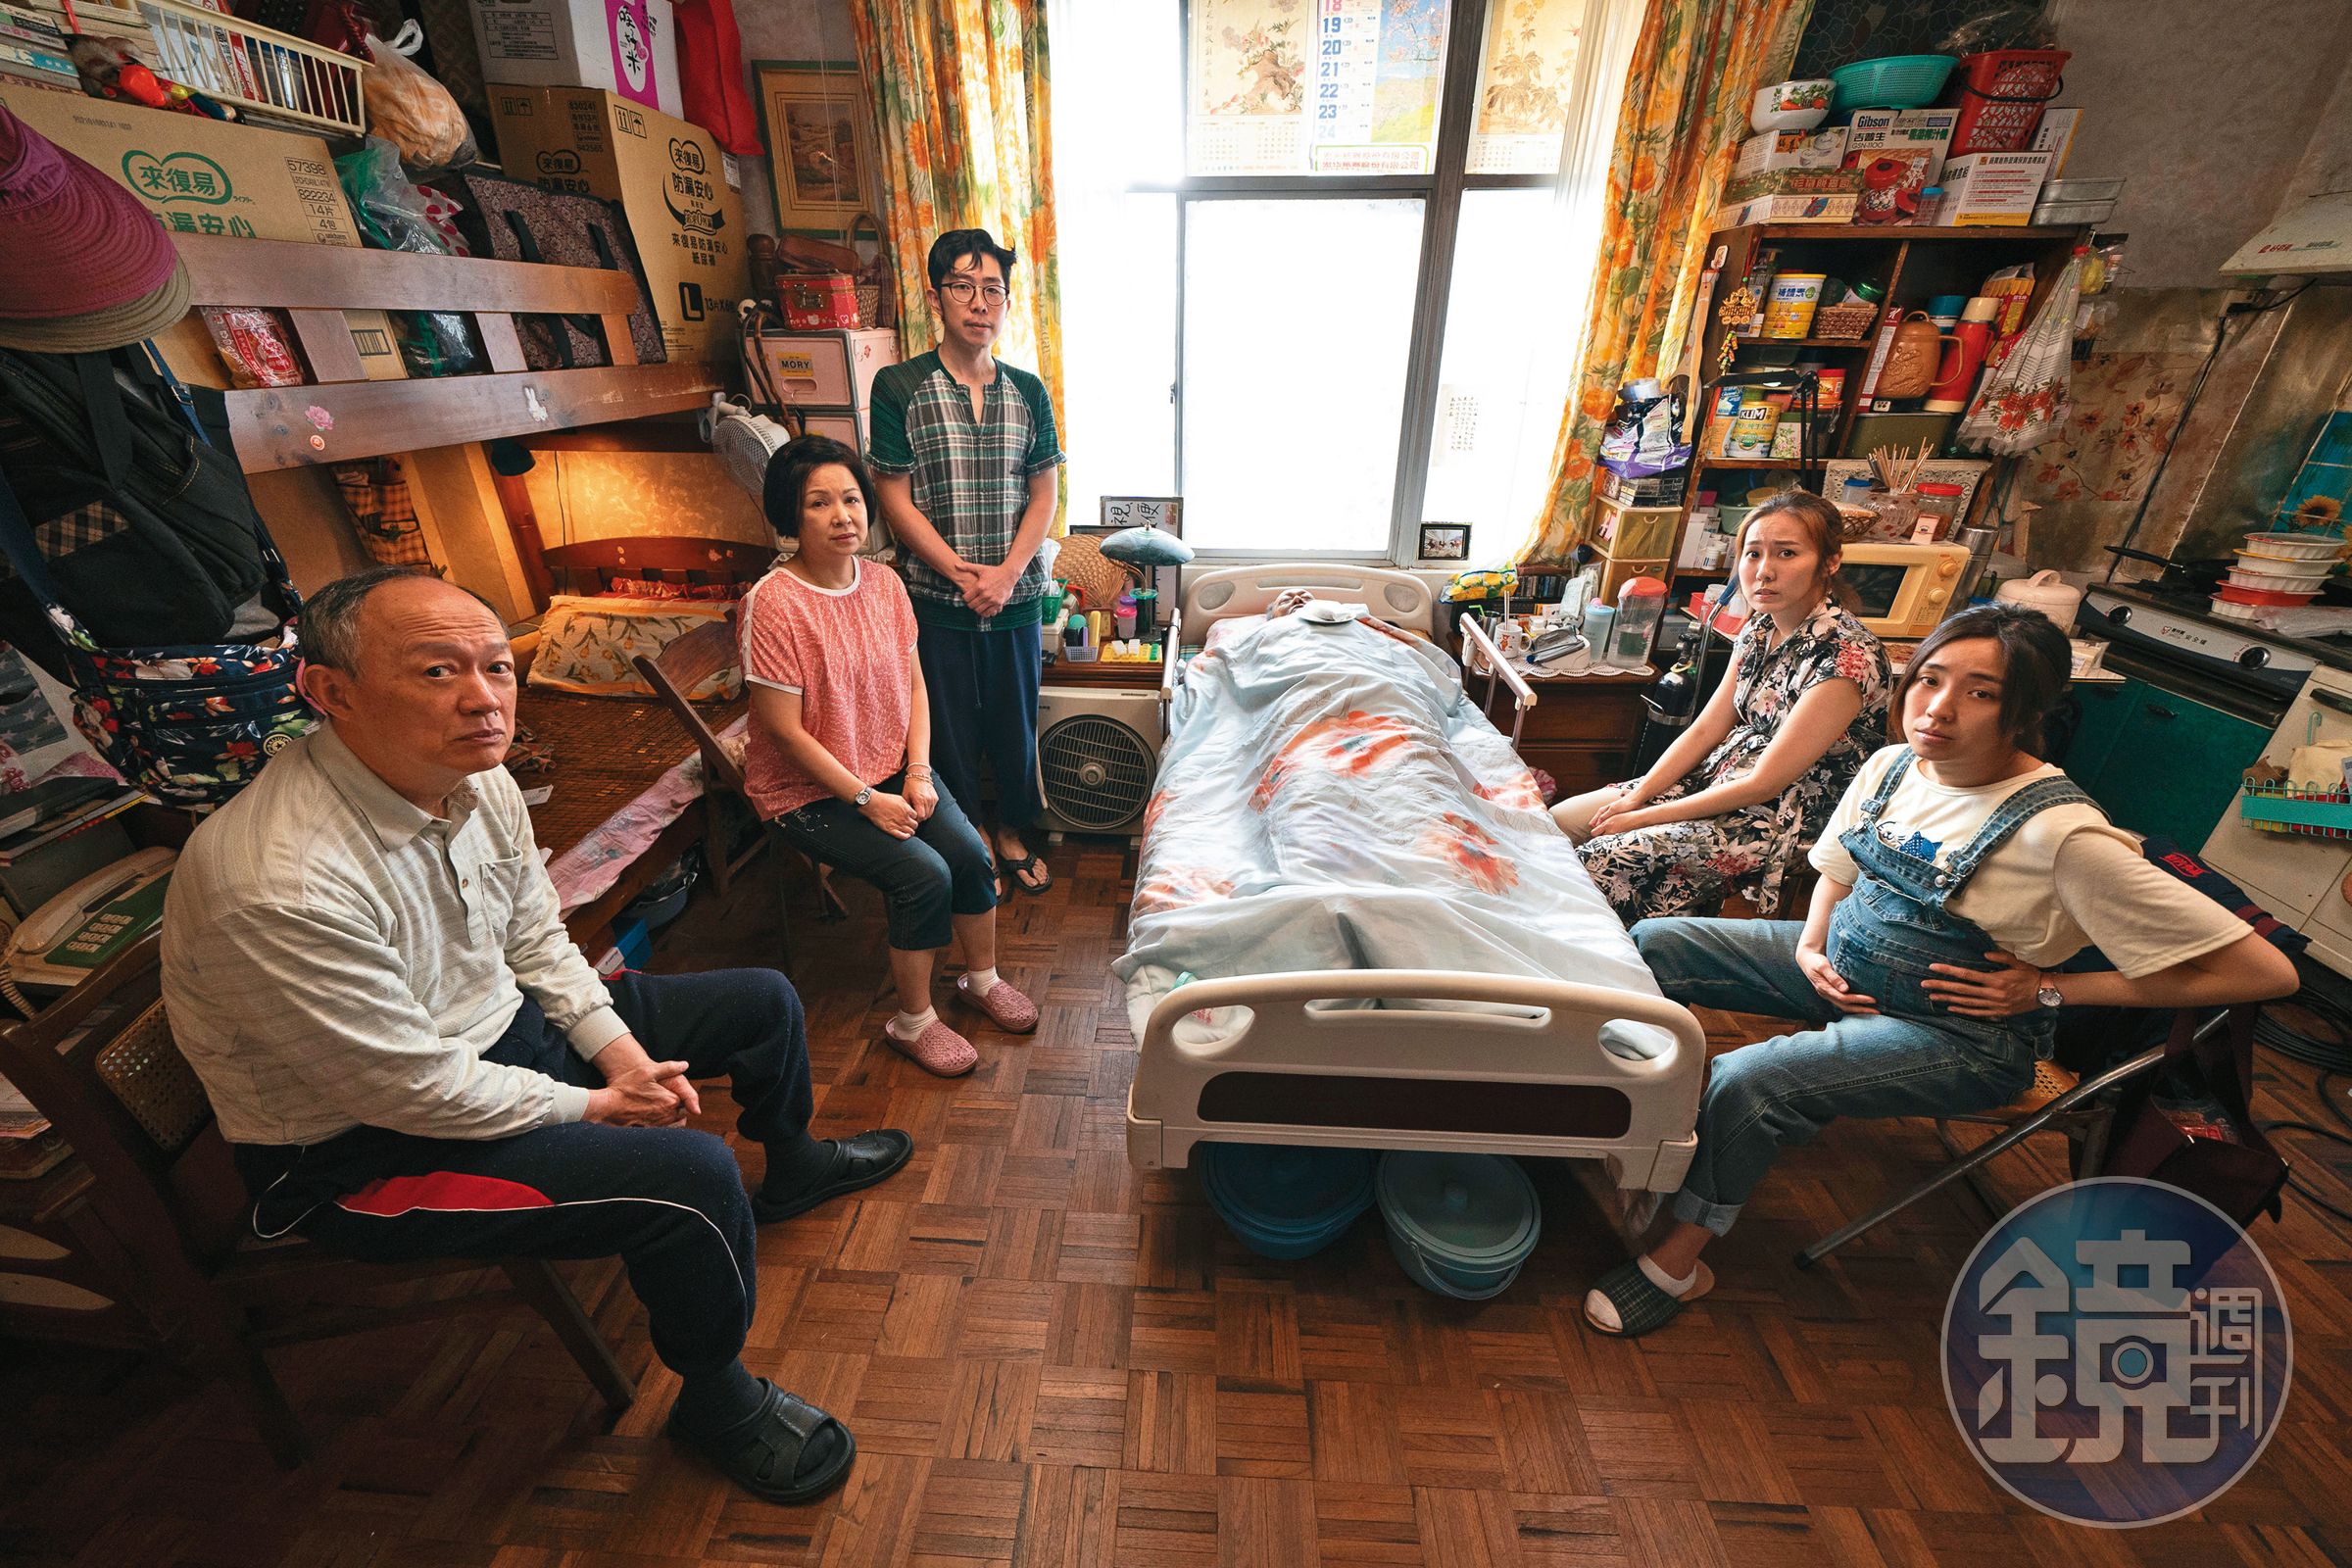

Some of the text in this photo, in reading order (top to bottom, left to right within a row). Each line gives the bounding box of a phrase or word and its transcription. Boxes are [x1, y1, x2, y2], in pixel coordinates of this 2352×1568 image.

[1323, 17, 1342, 33] 19
[1322, 39, 1342, 56] 20
[1320, 62, 1339, 77] 21
[1319, 83, 1339, 98] 22
[1318, 104, 1338, 120] 23
[1857, 115, 1890, 127] Gibson
[1318, 125, 1337, 139] 24
[1853, 132, 1886, 142] 吉普生
[674, 148, 701, 170] 來復易
[286, 159, 326, 175] 57398
[138, 166, 217, 196] 來復易
[671, 172, 714, 201] 防漏安心
[298, 189, 336, 203] 822234
[309, 204, 334, 217] 14片
[319, 219, 337, 230] 4包
[683, 285, 702, 318] L
[781, 360, 809, 369] MORY
[1740, 408, 1766, 420] KLIM
